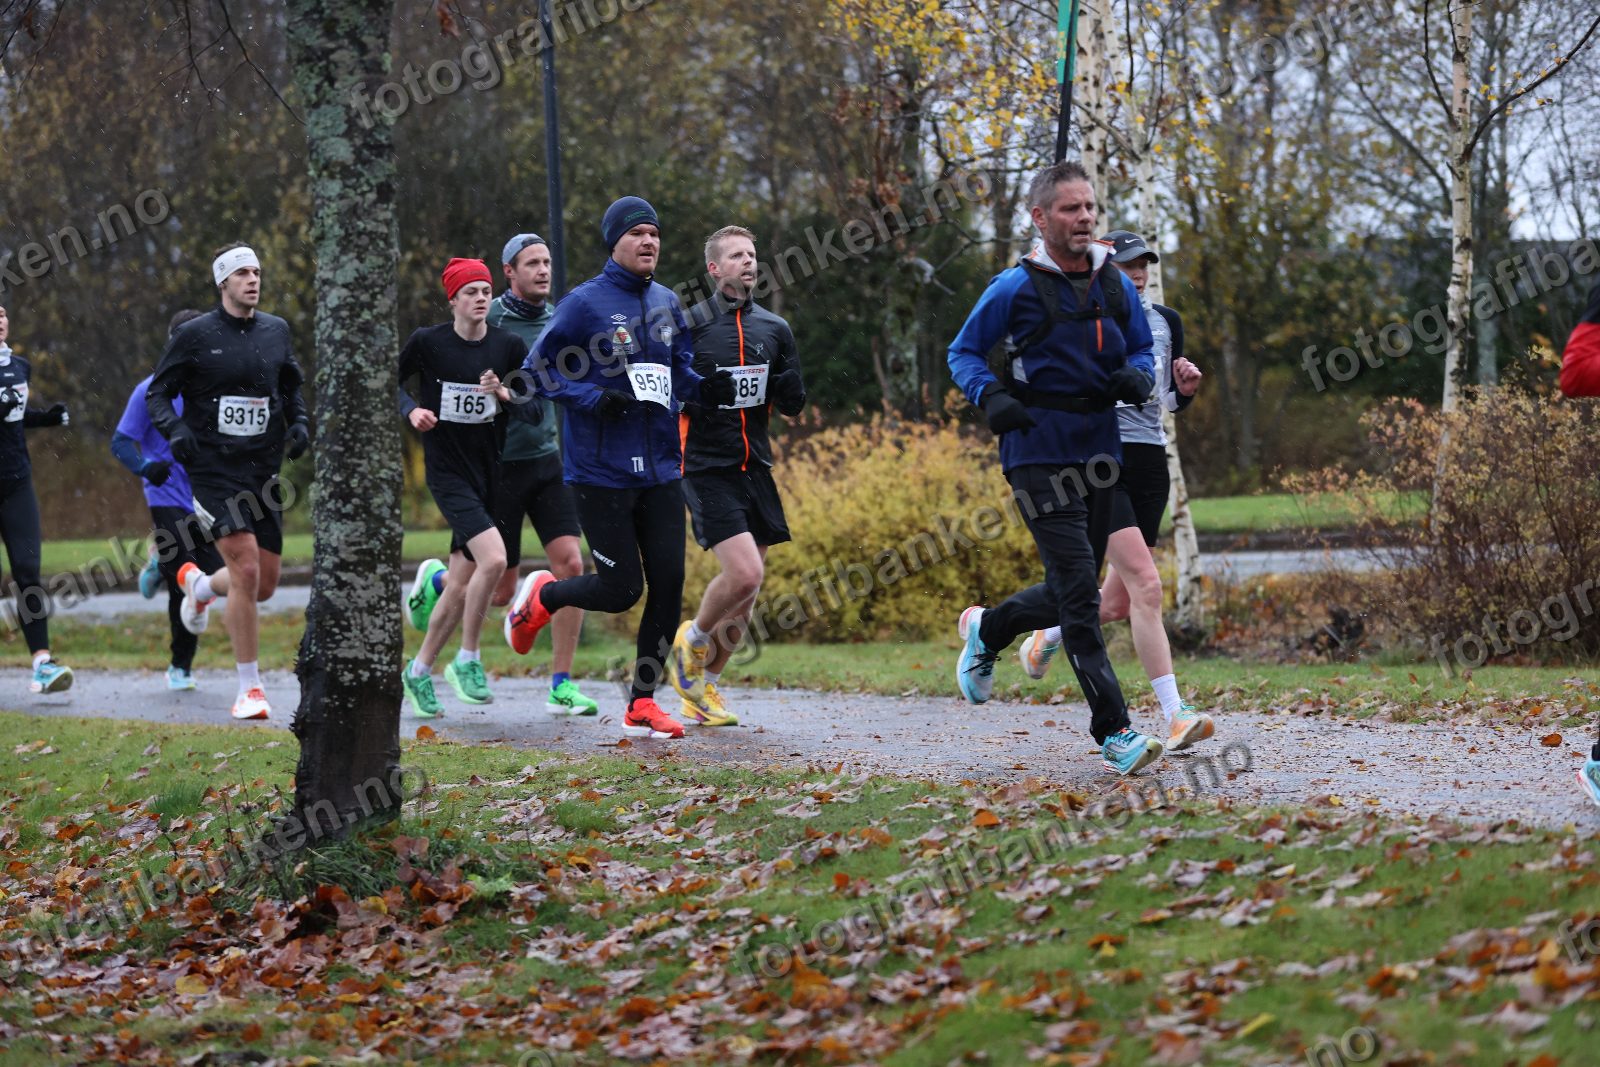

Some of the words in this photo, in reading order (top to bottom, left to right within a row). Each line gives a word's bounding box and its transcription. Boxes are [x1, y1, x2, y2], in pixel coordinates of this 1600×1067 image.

[634, 373, 670, 397] 9518
[738, 377, 759, 398] 85
[453, 394, 486, 415] 165
[224, 406, 267, 426] 9315
